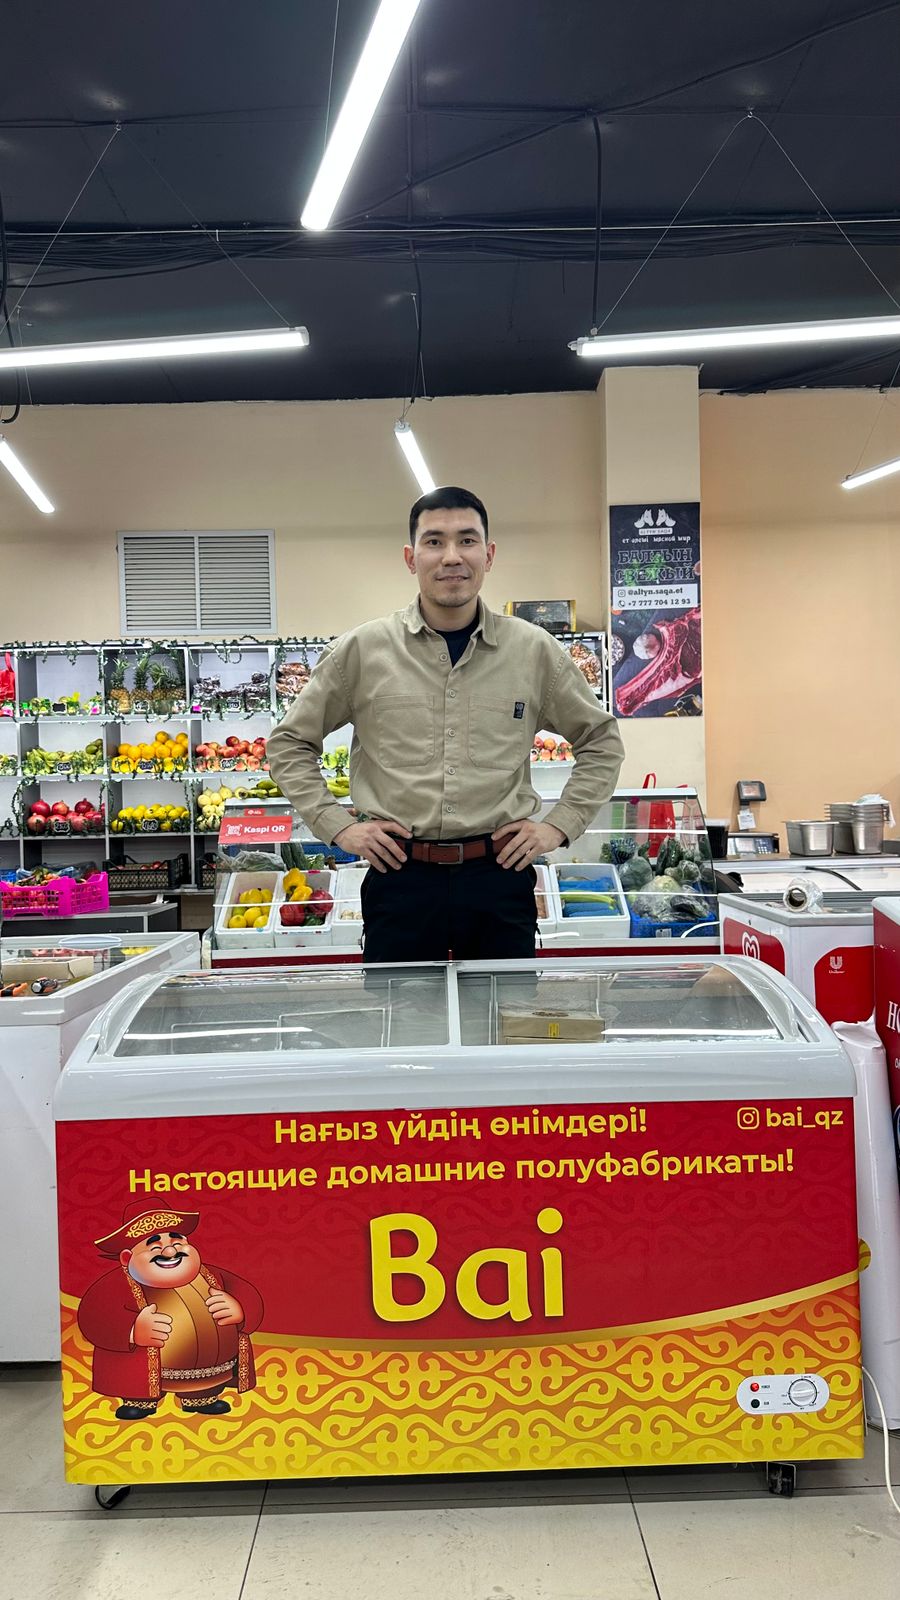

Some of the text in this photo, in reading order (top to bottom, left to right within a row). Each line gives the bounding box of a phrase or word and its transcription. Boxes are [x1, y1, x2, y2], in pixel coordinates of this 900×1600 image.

[628, 587, 683, 596] @altyn.saqa.et
[243, 826, 270, 834] Kaspi
[276, 1107, 645, 1144] Нағыз үйдің өнімдері!
[767, 1108, 842, 1128] bai_qz
[130, 1149, 792, 1192] Настоящие домашние полуфабрикаты!
[370, 1208, 563, 1322] Bai
